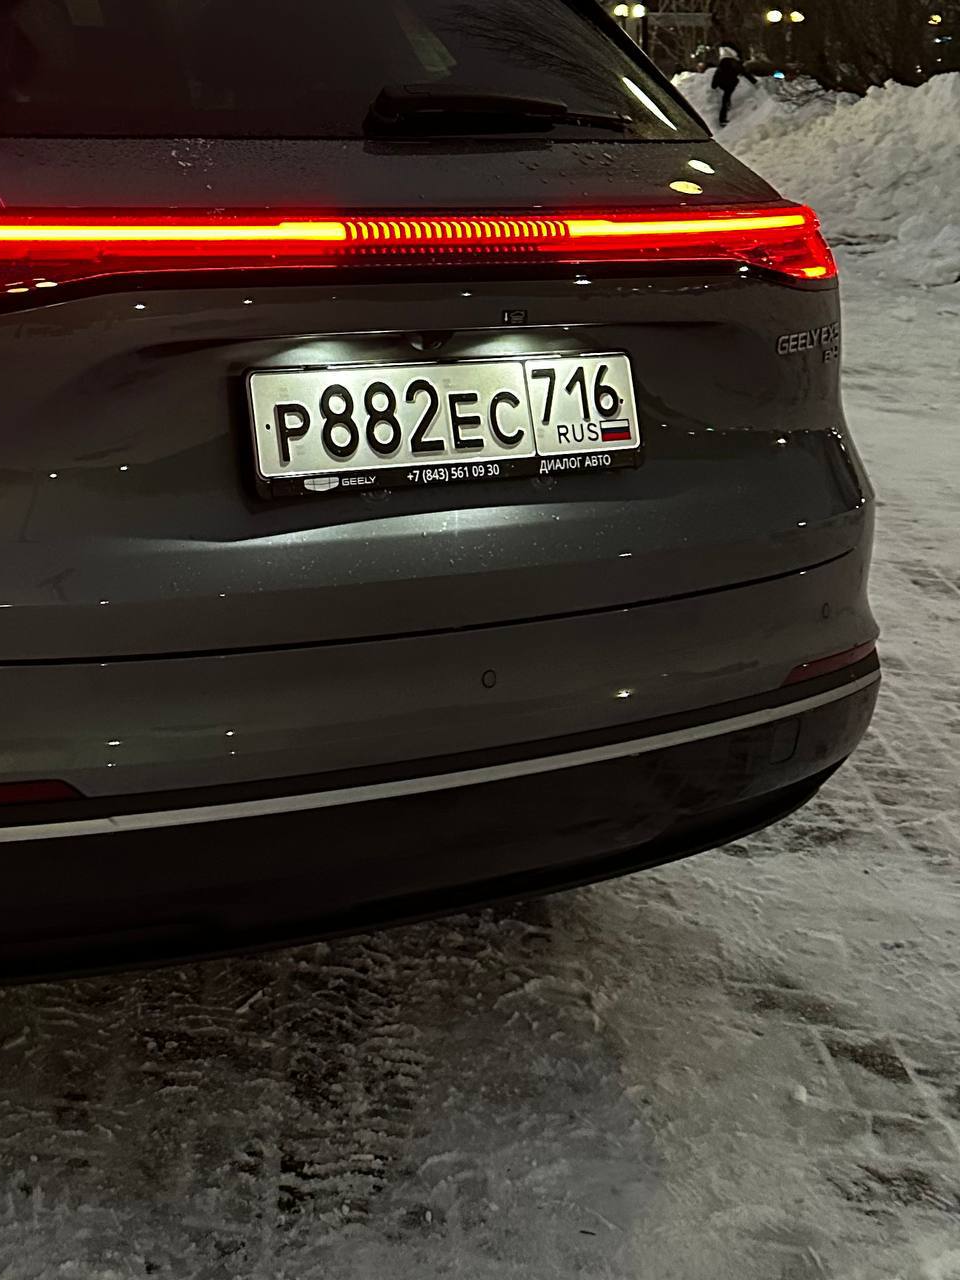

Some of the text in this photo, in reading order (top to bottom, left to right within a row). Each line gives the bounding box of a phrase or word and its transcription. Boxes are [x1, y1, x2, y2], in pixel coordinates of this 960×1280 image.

[778, 328, 820, 355] GEELY
[531, 364, 619, 426] 716
[557, 422, 599, 444] RUS
[407, 464, 500, 484] +7 (843) 561 09 30
[539, 454, 612, 474] ДИАЛОГ АВТО
[341, 475, 377, 487] GEELY
